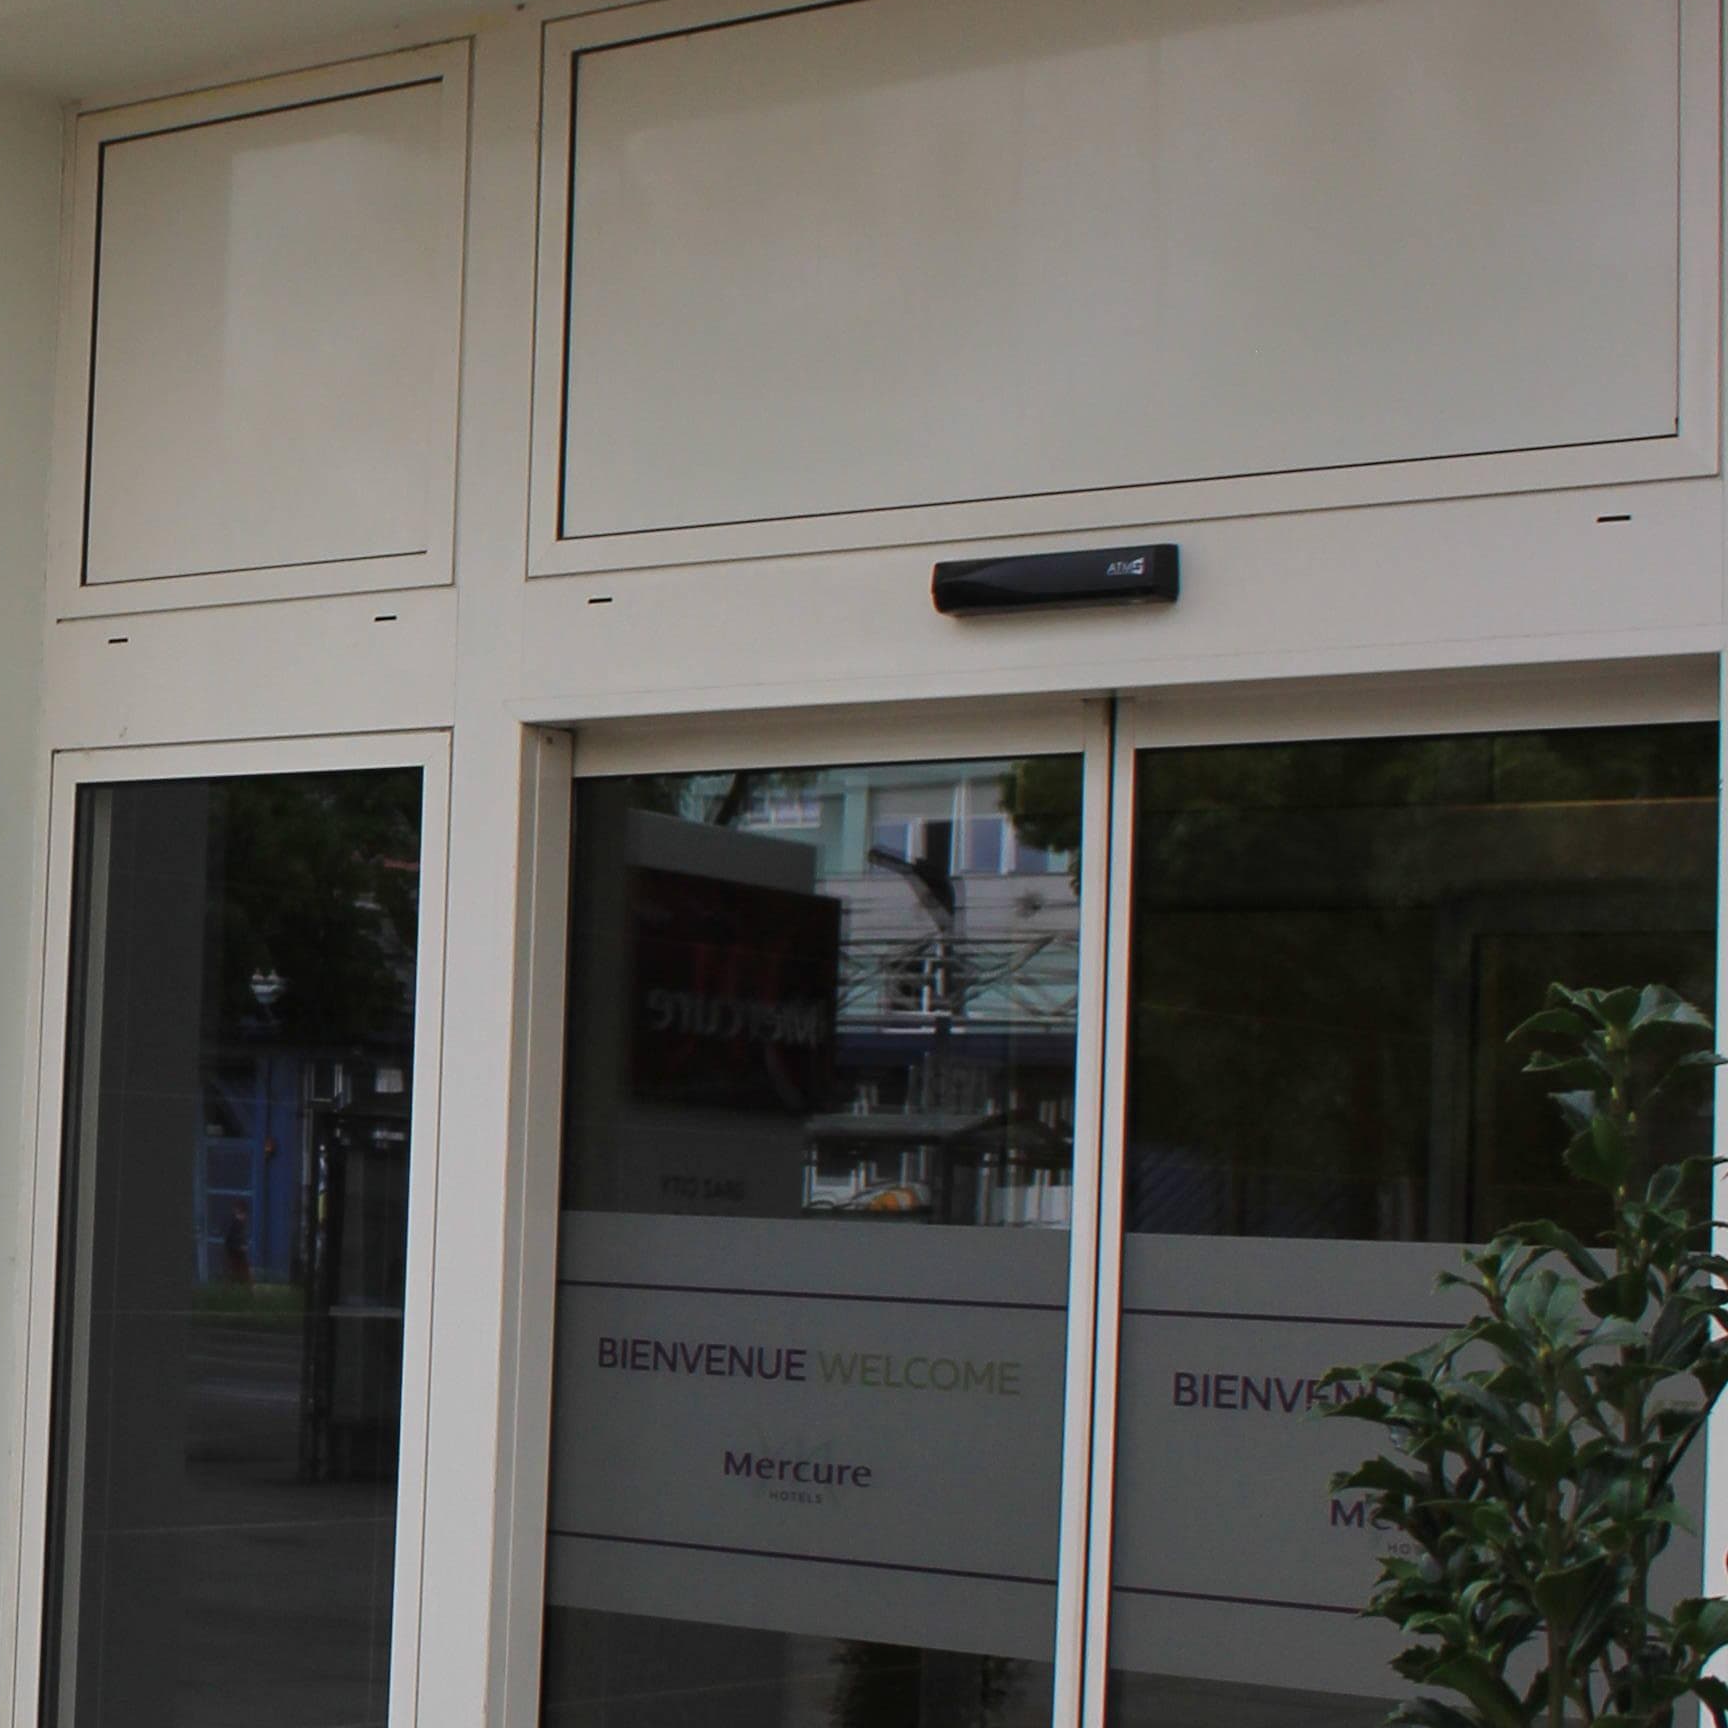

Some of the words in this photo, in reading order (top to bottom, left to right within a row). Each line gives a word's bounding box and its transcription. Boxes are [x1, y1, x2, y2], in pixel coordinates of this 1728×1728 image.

[596, 1337, 808, 1382] BIENVENUE
[815, 1350, 1023, 1396] WELCOME
[722, 1450, 873, 1488] Mercure
[769, 1489, 824, 1504] HOTELS
